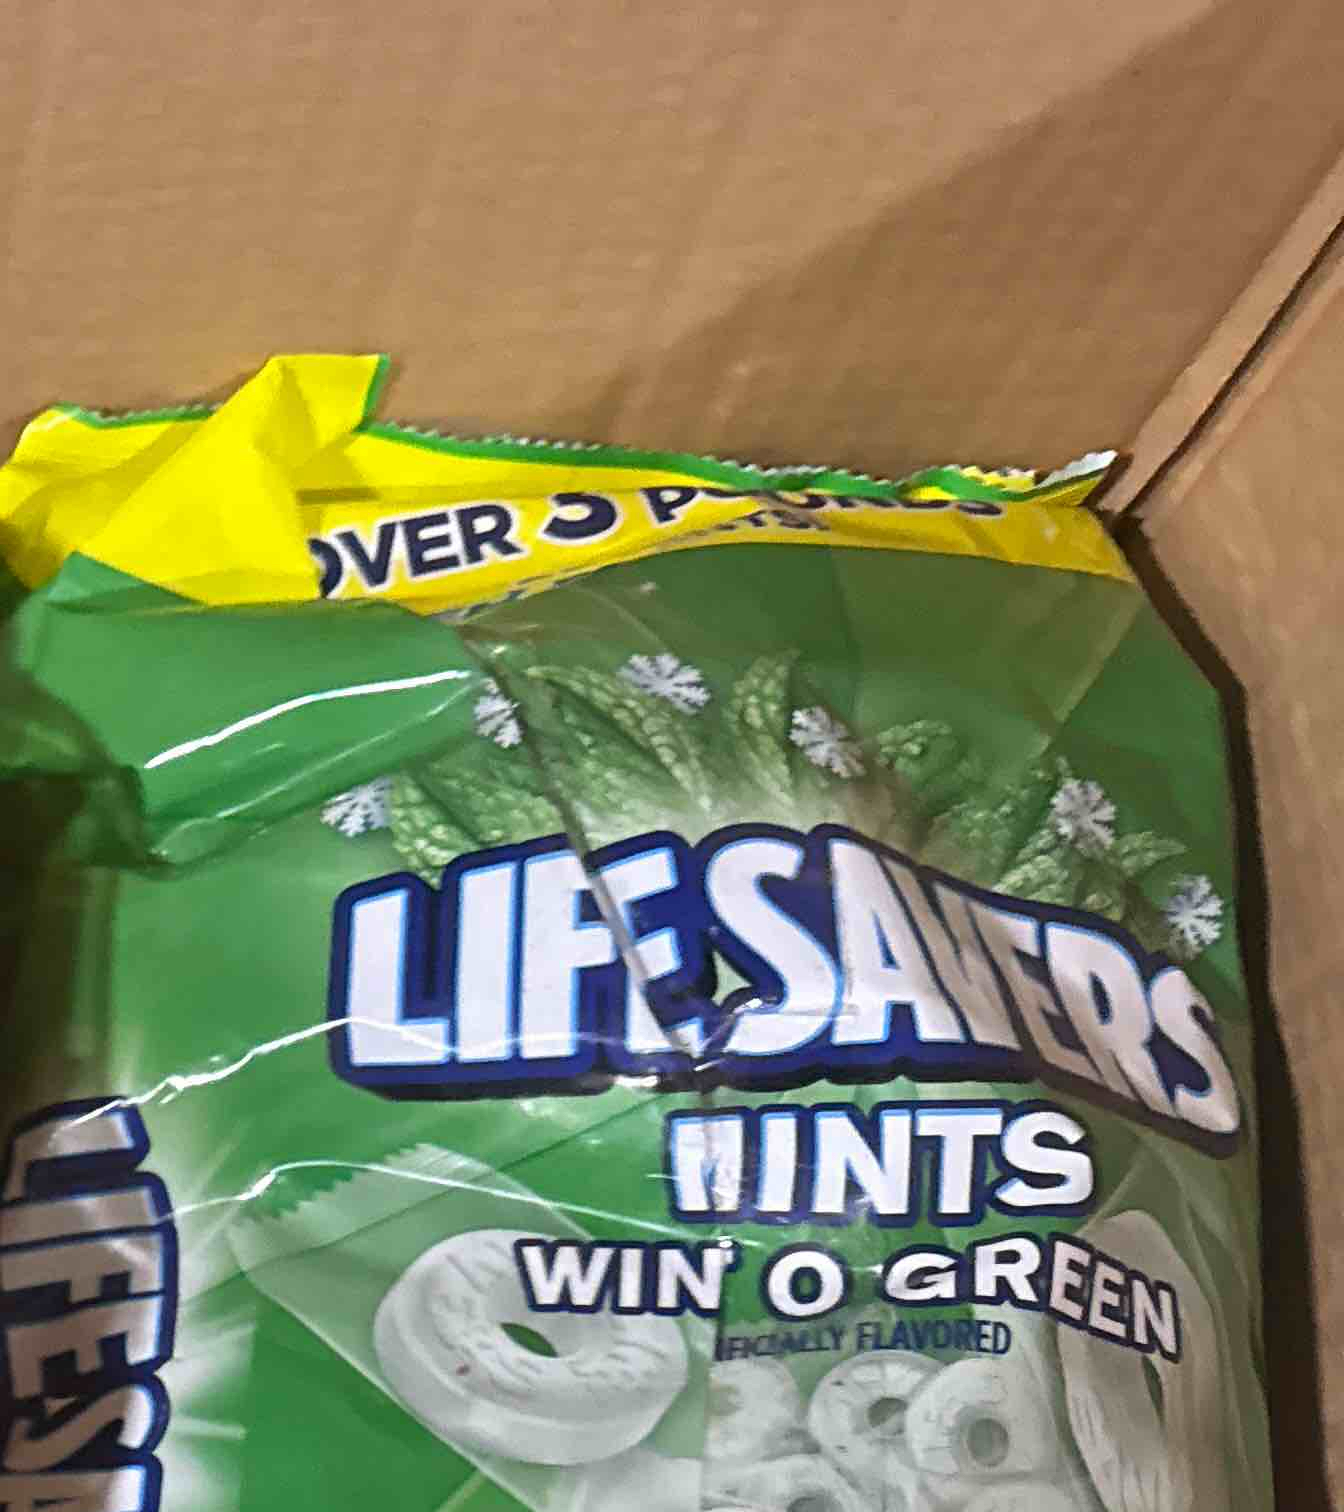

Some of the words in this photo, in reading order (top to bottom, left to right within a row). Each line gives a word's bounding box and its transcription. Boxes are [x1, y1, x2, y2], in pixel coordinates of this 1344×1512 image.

[520, 1242, 735, 1309] WIN
[768, 1249, 847, 1318] O
[882, 1238, 1179, 1358] GREEN
[857, 1318, 1013, 1355] FLAVORED
